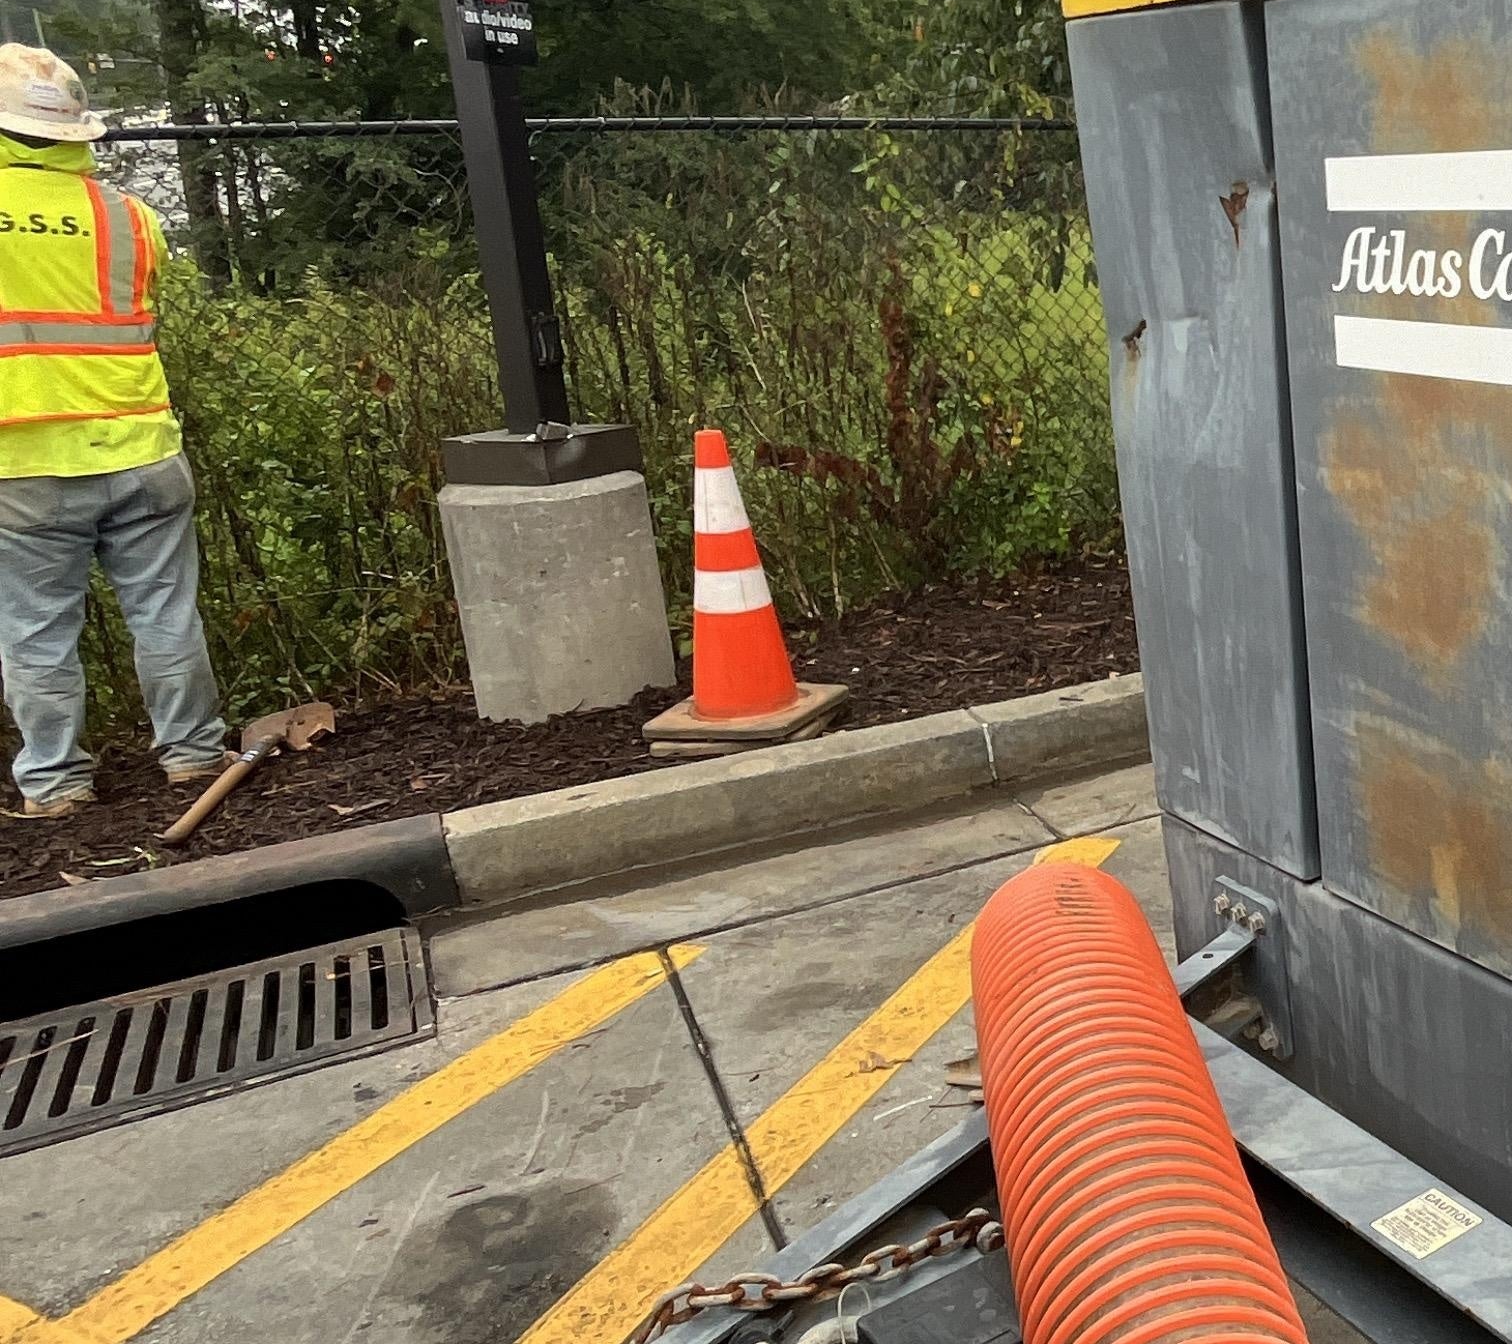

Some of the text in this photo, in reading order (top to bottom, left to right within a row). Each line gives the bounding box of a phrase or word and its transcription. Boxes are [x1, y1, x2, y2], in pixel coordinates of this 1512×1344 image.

[497, 31, 519, 45] use
[1331, 226, 1463, 298] Atlas
[1425, 1193, 1475, 1227] CAUTION
